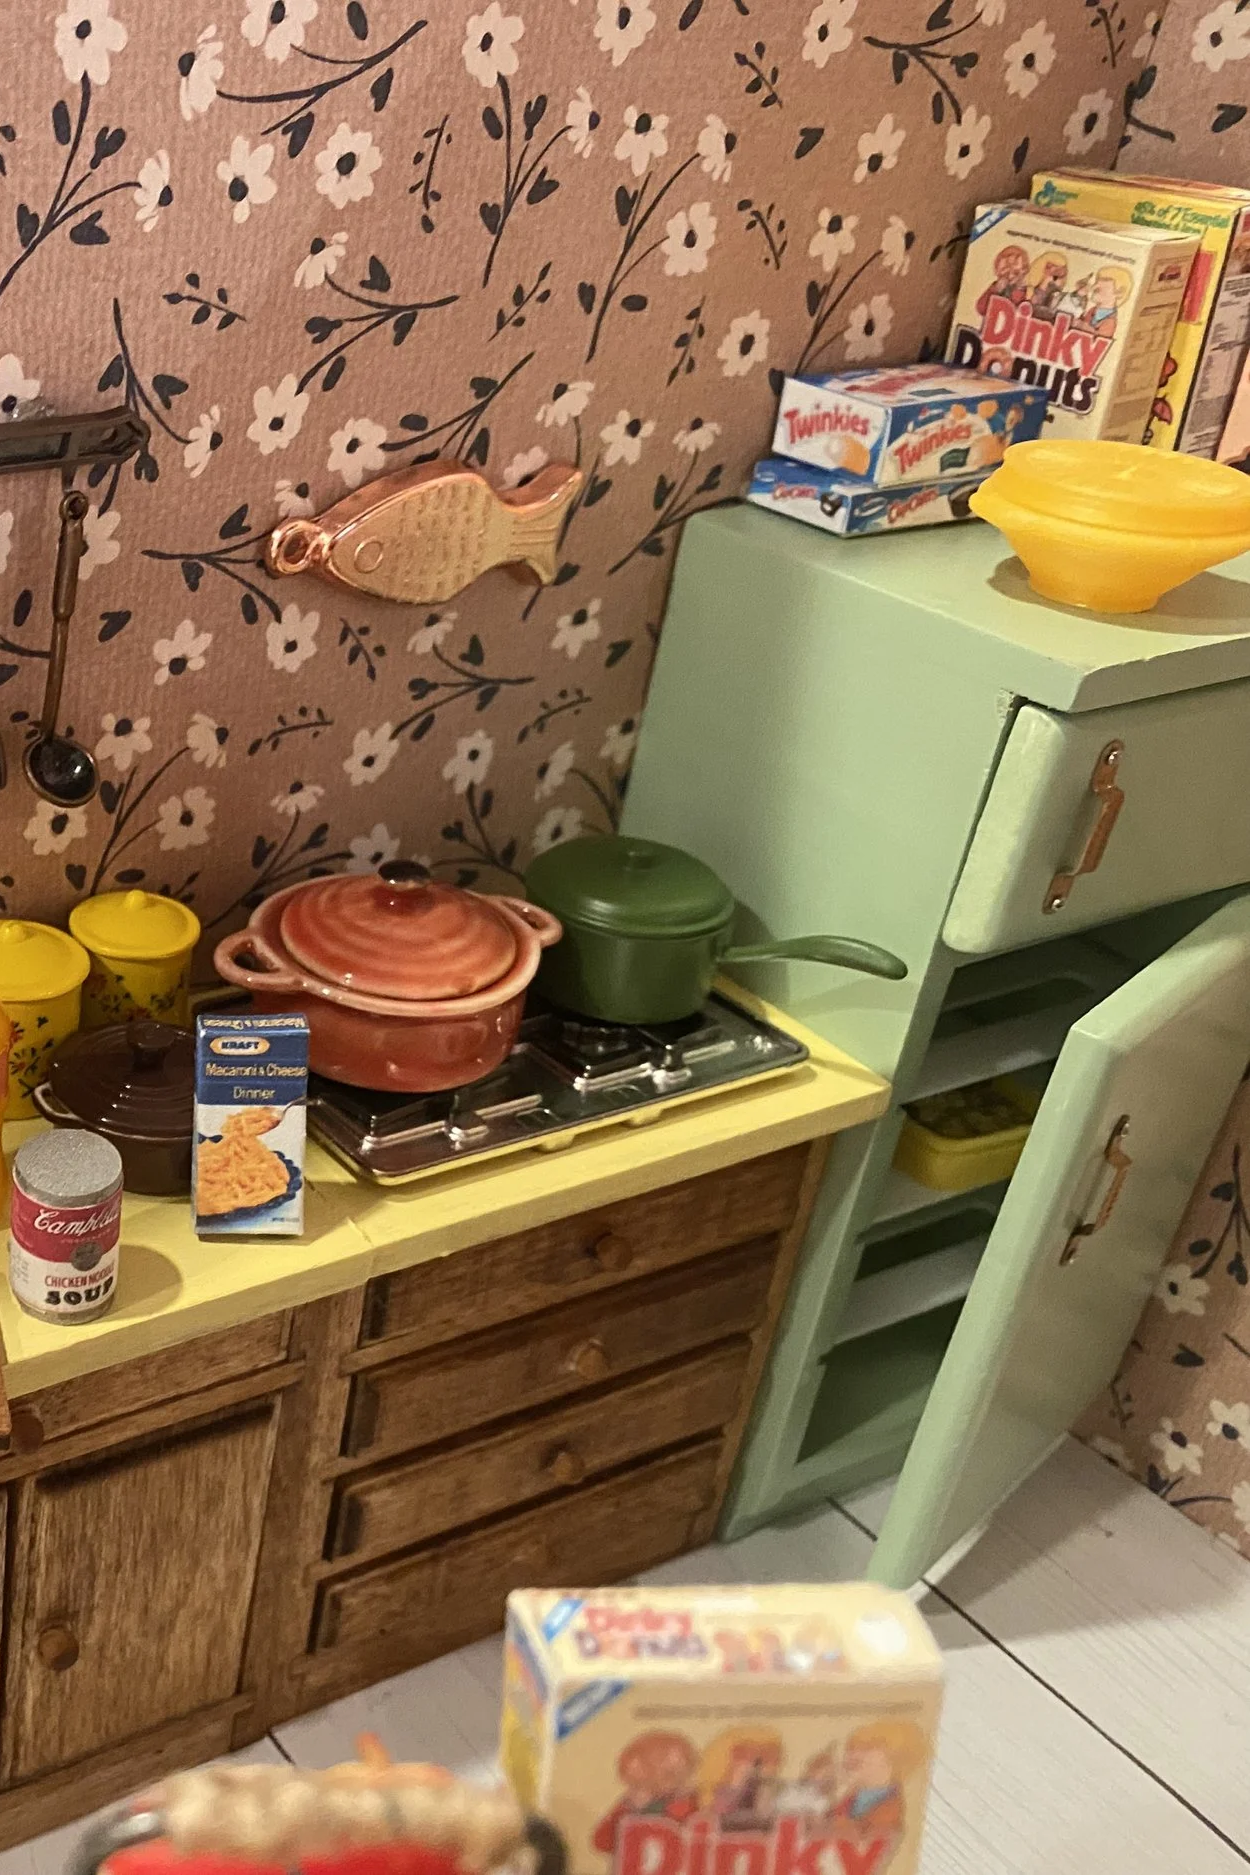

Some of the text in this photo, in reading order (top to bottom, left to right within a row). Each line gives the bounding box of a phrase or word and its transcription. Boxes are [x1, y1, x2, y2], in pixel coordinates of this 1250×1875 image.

[981, 295, 1114, 377] Dinky
[953, 326, 1100, 413] Donuts
[783, 403, 870, 444] Twinkies
[894, 422, 972, 474] Twinkies
[221, 1041, 260, 1050] KRAFT
[205, 1062, 257, 1076] Macaroni
[266, 1062, 308, 1077] Cheese
[233, 1085, 276, 1099] Dinner
[44, 1274, 88, 1289] CHICKEN
[45, 1275, 114, 1306] SOUP
